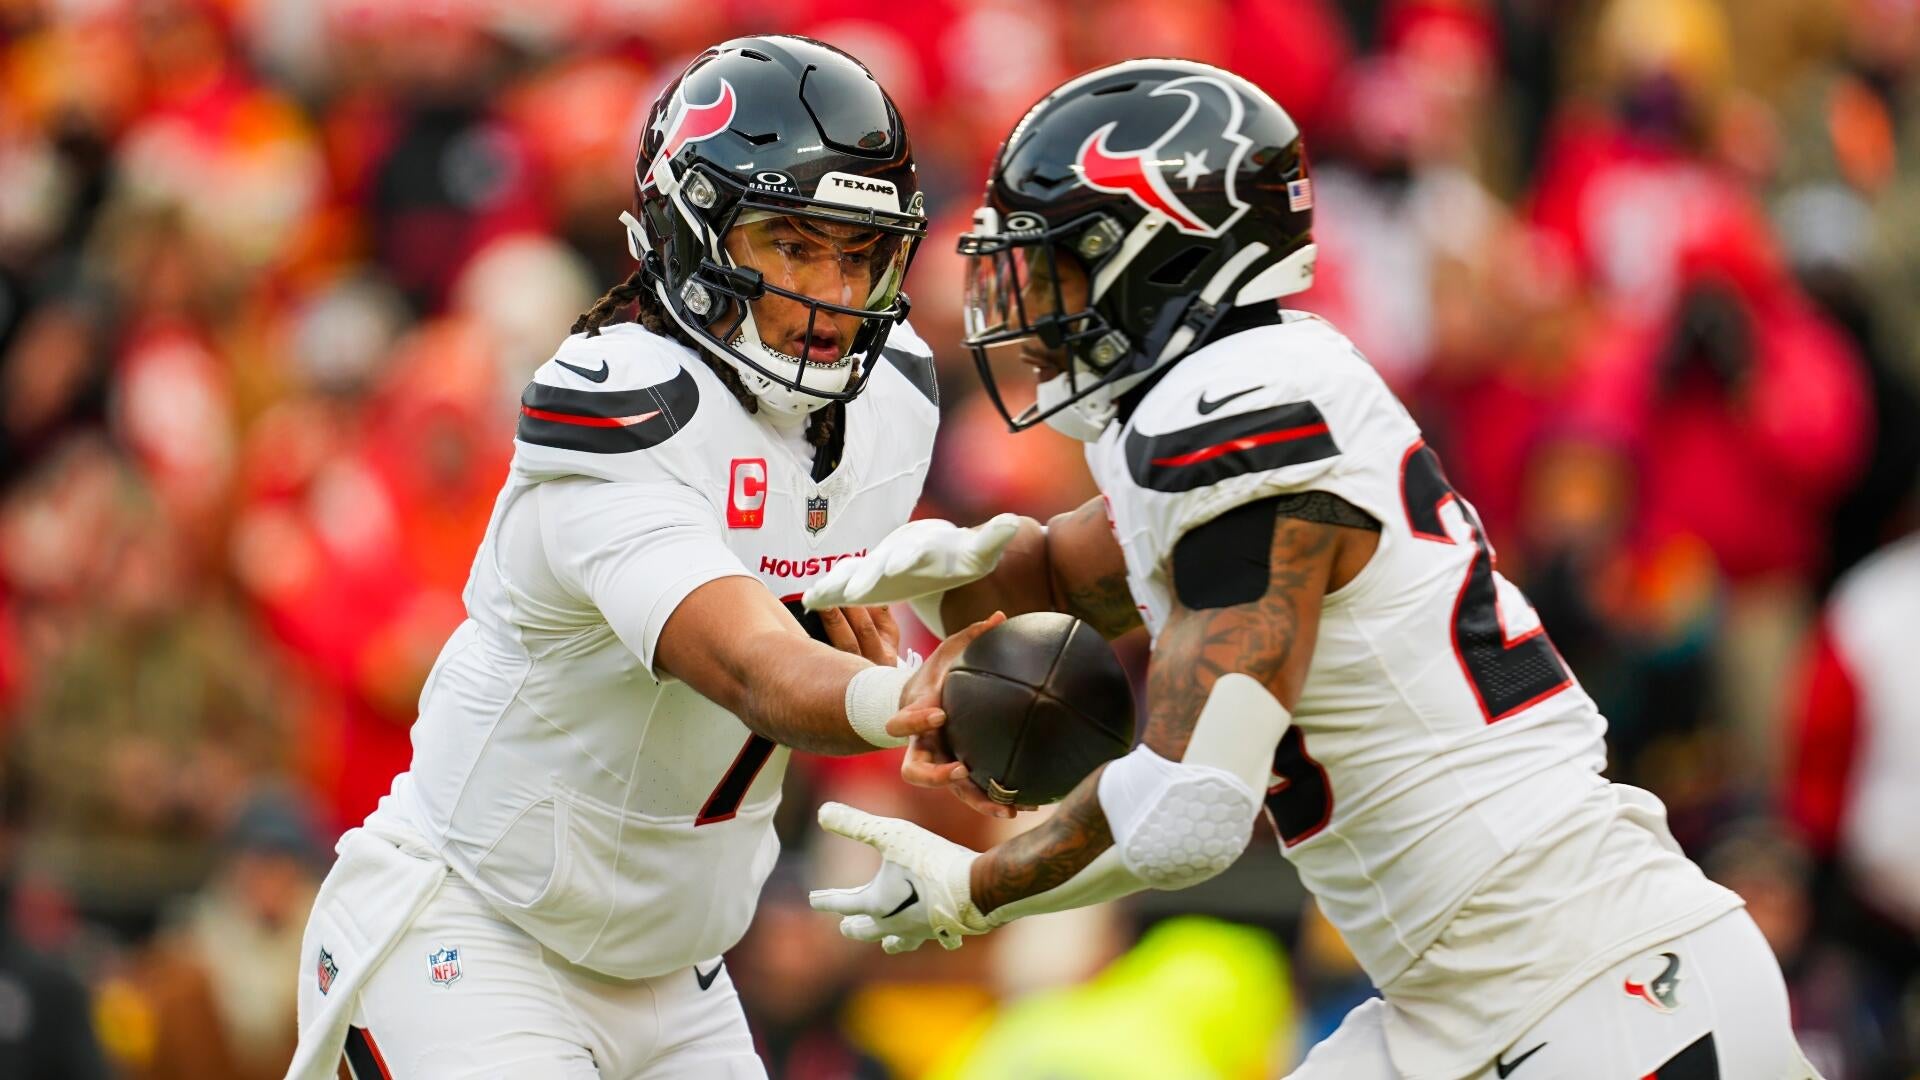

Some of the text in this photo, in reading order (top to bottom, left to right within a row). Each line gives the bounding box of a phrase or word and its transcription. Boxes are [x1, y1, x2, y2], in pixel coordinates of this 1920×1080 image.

[749, 182, 796, 193] OAKLEY
[832, 177, 895, 195] TEXANS
[734, 463, 765, 511] C
[808, 510, 826, 528] NFL
[433, 963, 457, 980] NFL
